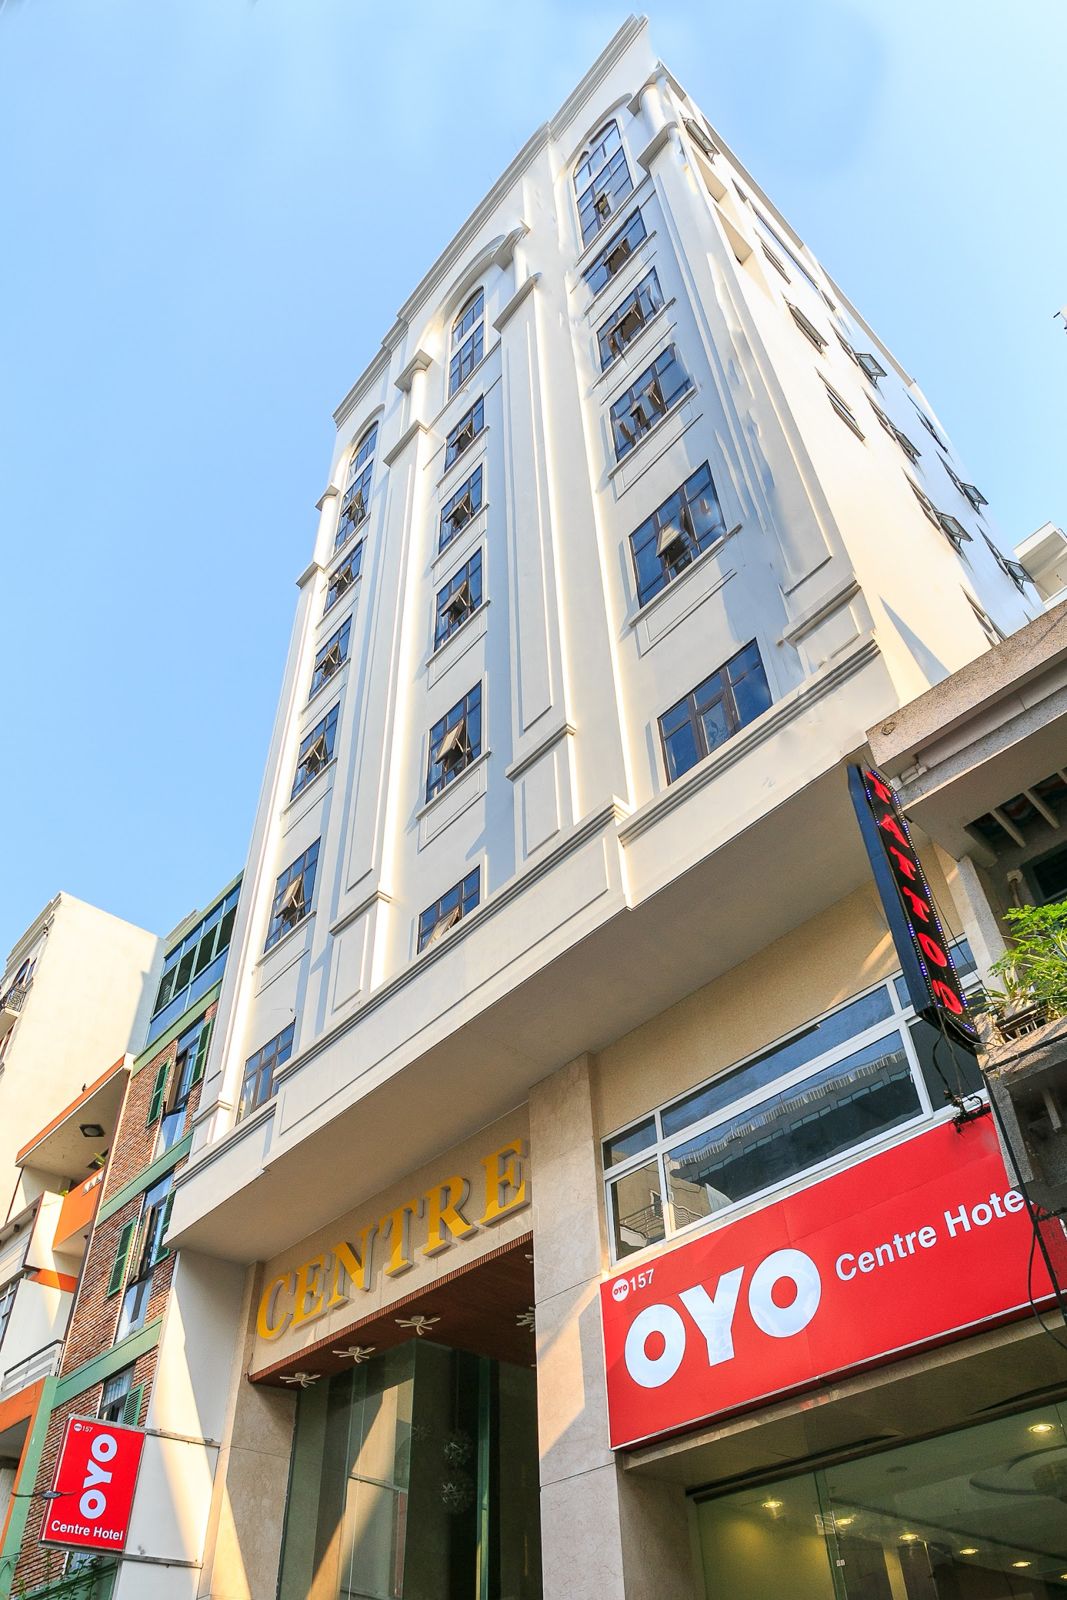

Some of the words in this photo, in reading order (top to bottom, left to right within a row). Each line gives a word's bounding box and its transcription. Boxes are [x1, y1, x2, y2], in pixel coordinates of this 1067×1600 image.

[256, 1138, 532, 1341] CENTRE
[630, 1268, 655, 1291] 157
[835, 1226, 938, 1281] Centre
[944, 1190, 1034, 1238] Hote
[624, 1248, 822, 1388] OYO
[79, 1433, 118, 1519] OYO
[51, 1520, 91, 1536] Centre
[93, 1526, 123, 1541] Hotel
